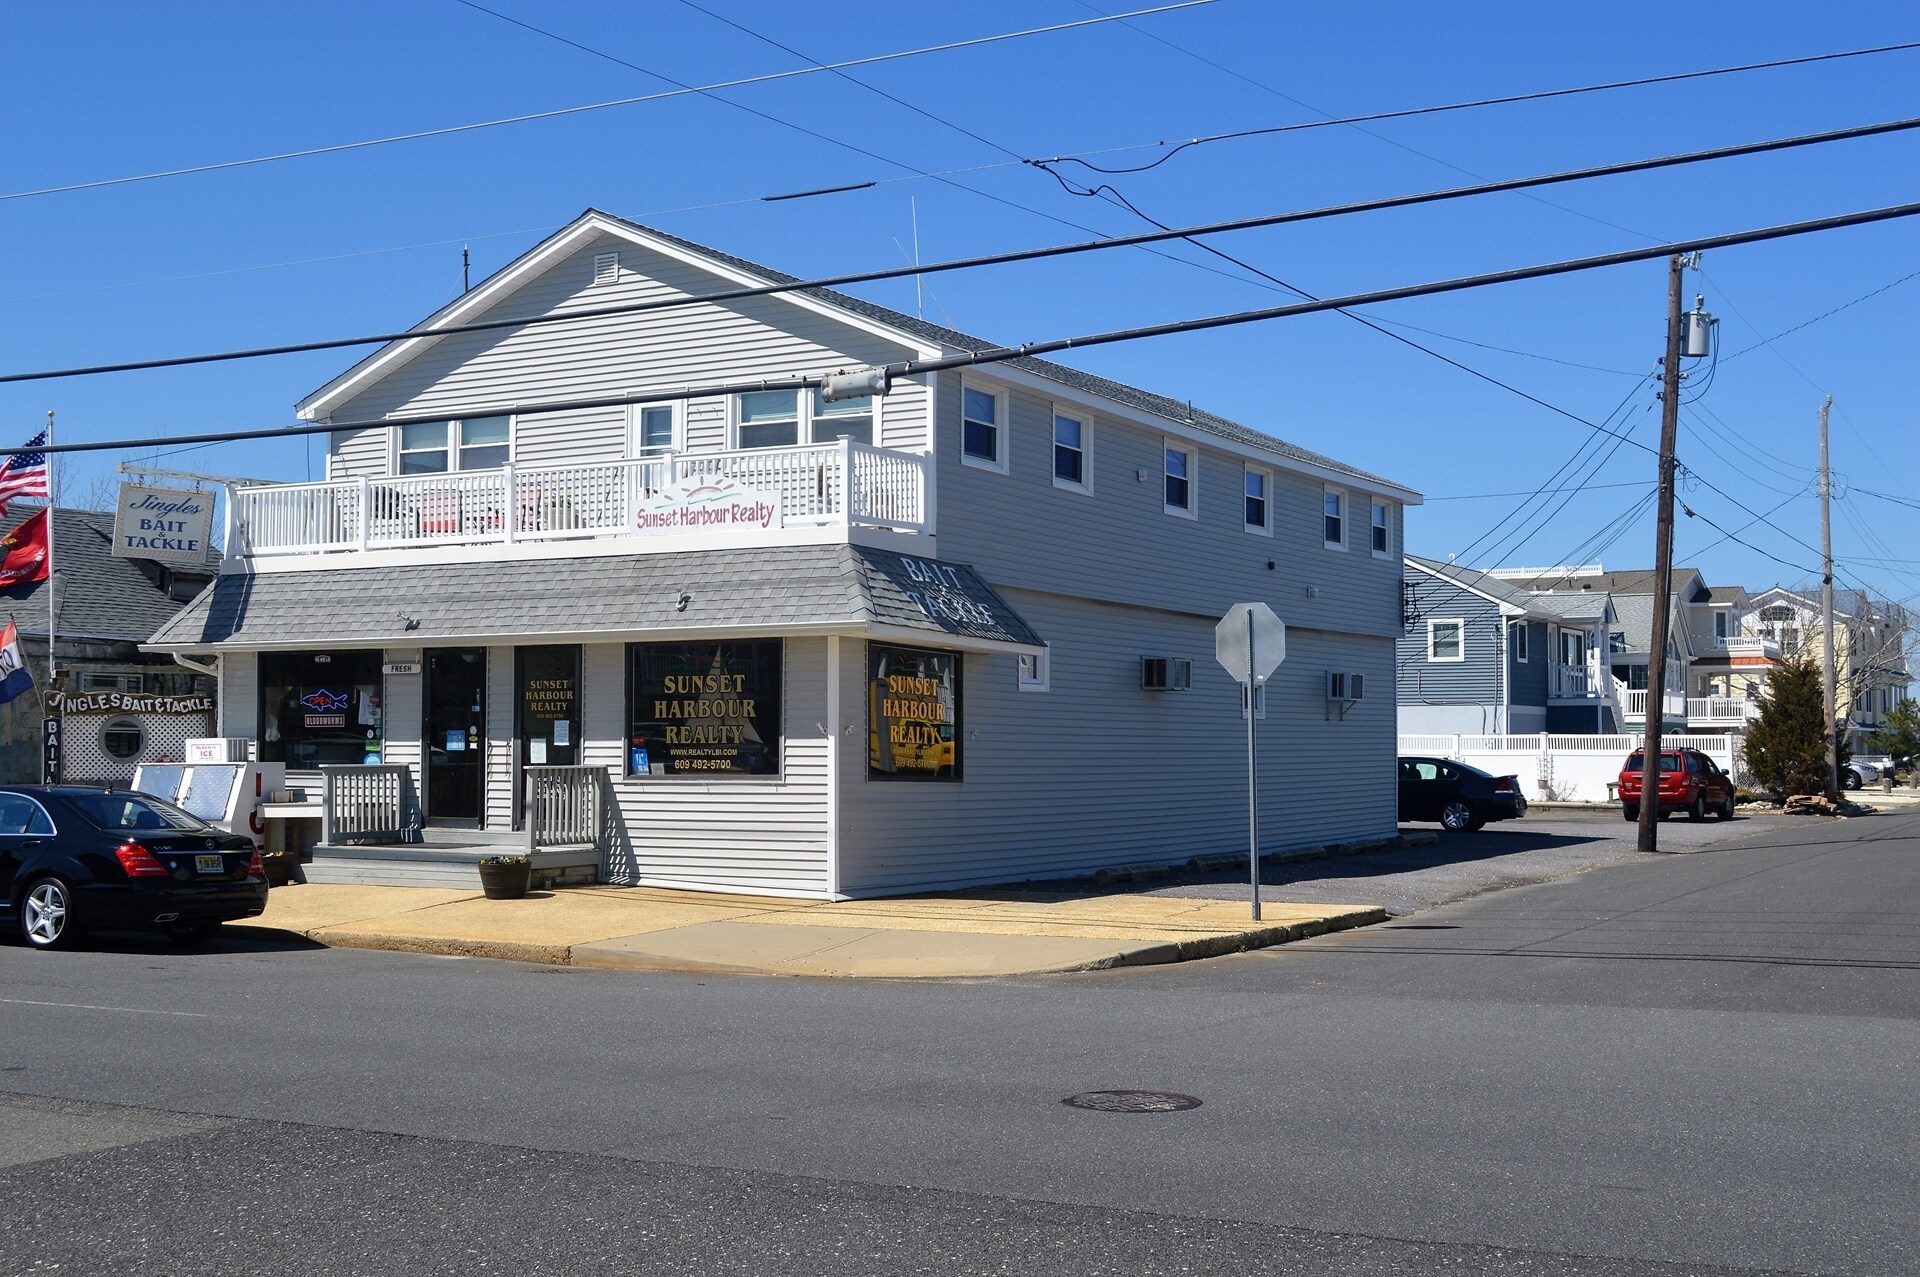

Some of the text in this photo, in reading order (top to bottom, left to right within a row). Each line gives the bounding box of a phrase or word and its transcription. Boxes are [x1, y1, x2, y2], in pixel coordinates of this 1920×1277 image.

[129, 494, 204, 518] Jingles
[637, 500, 775, 529] Sunset Harbour Realty
[140, 518, 187, 532] BAIT
[124, 535, 199, 551] TACKLE
[900, 557, 962, 589] BAIT
[906, 591, 997, 625] TACKLE
[530, 680, 569, 689] SUNSET
[664, 674, 746, 694] SUNSET
[889, 675, 939, 696] SUNSET
[121, 696, 153, 712] BAIT
[164, 698, 213, 713] TACKLE
[309, 696, 332, 705] OPEN
[525, 691, 574, 700] HARBOUR
[531, 701, 568, 711] REALTY
[654, 699, 756, 719] HARBOUR
[883, 699, 944, 720] HARBOUR
[306, 716, 343, 725] BLOODWORMS
[665, 725, 744, 744] REALTY
[890, 725, 939, 745] REALTY
[669, 748, 738, 756] WWW.REALTYLBI.COM
[674, 759, 690, 769] 609
[692, 759, 731, 769] 492-5700
